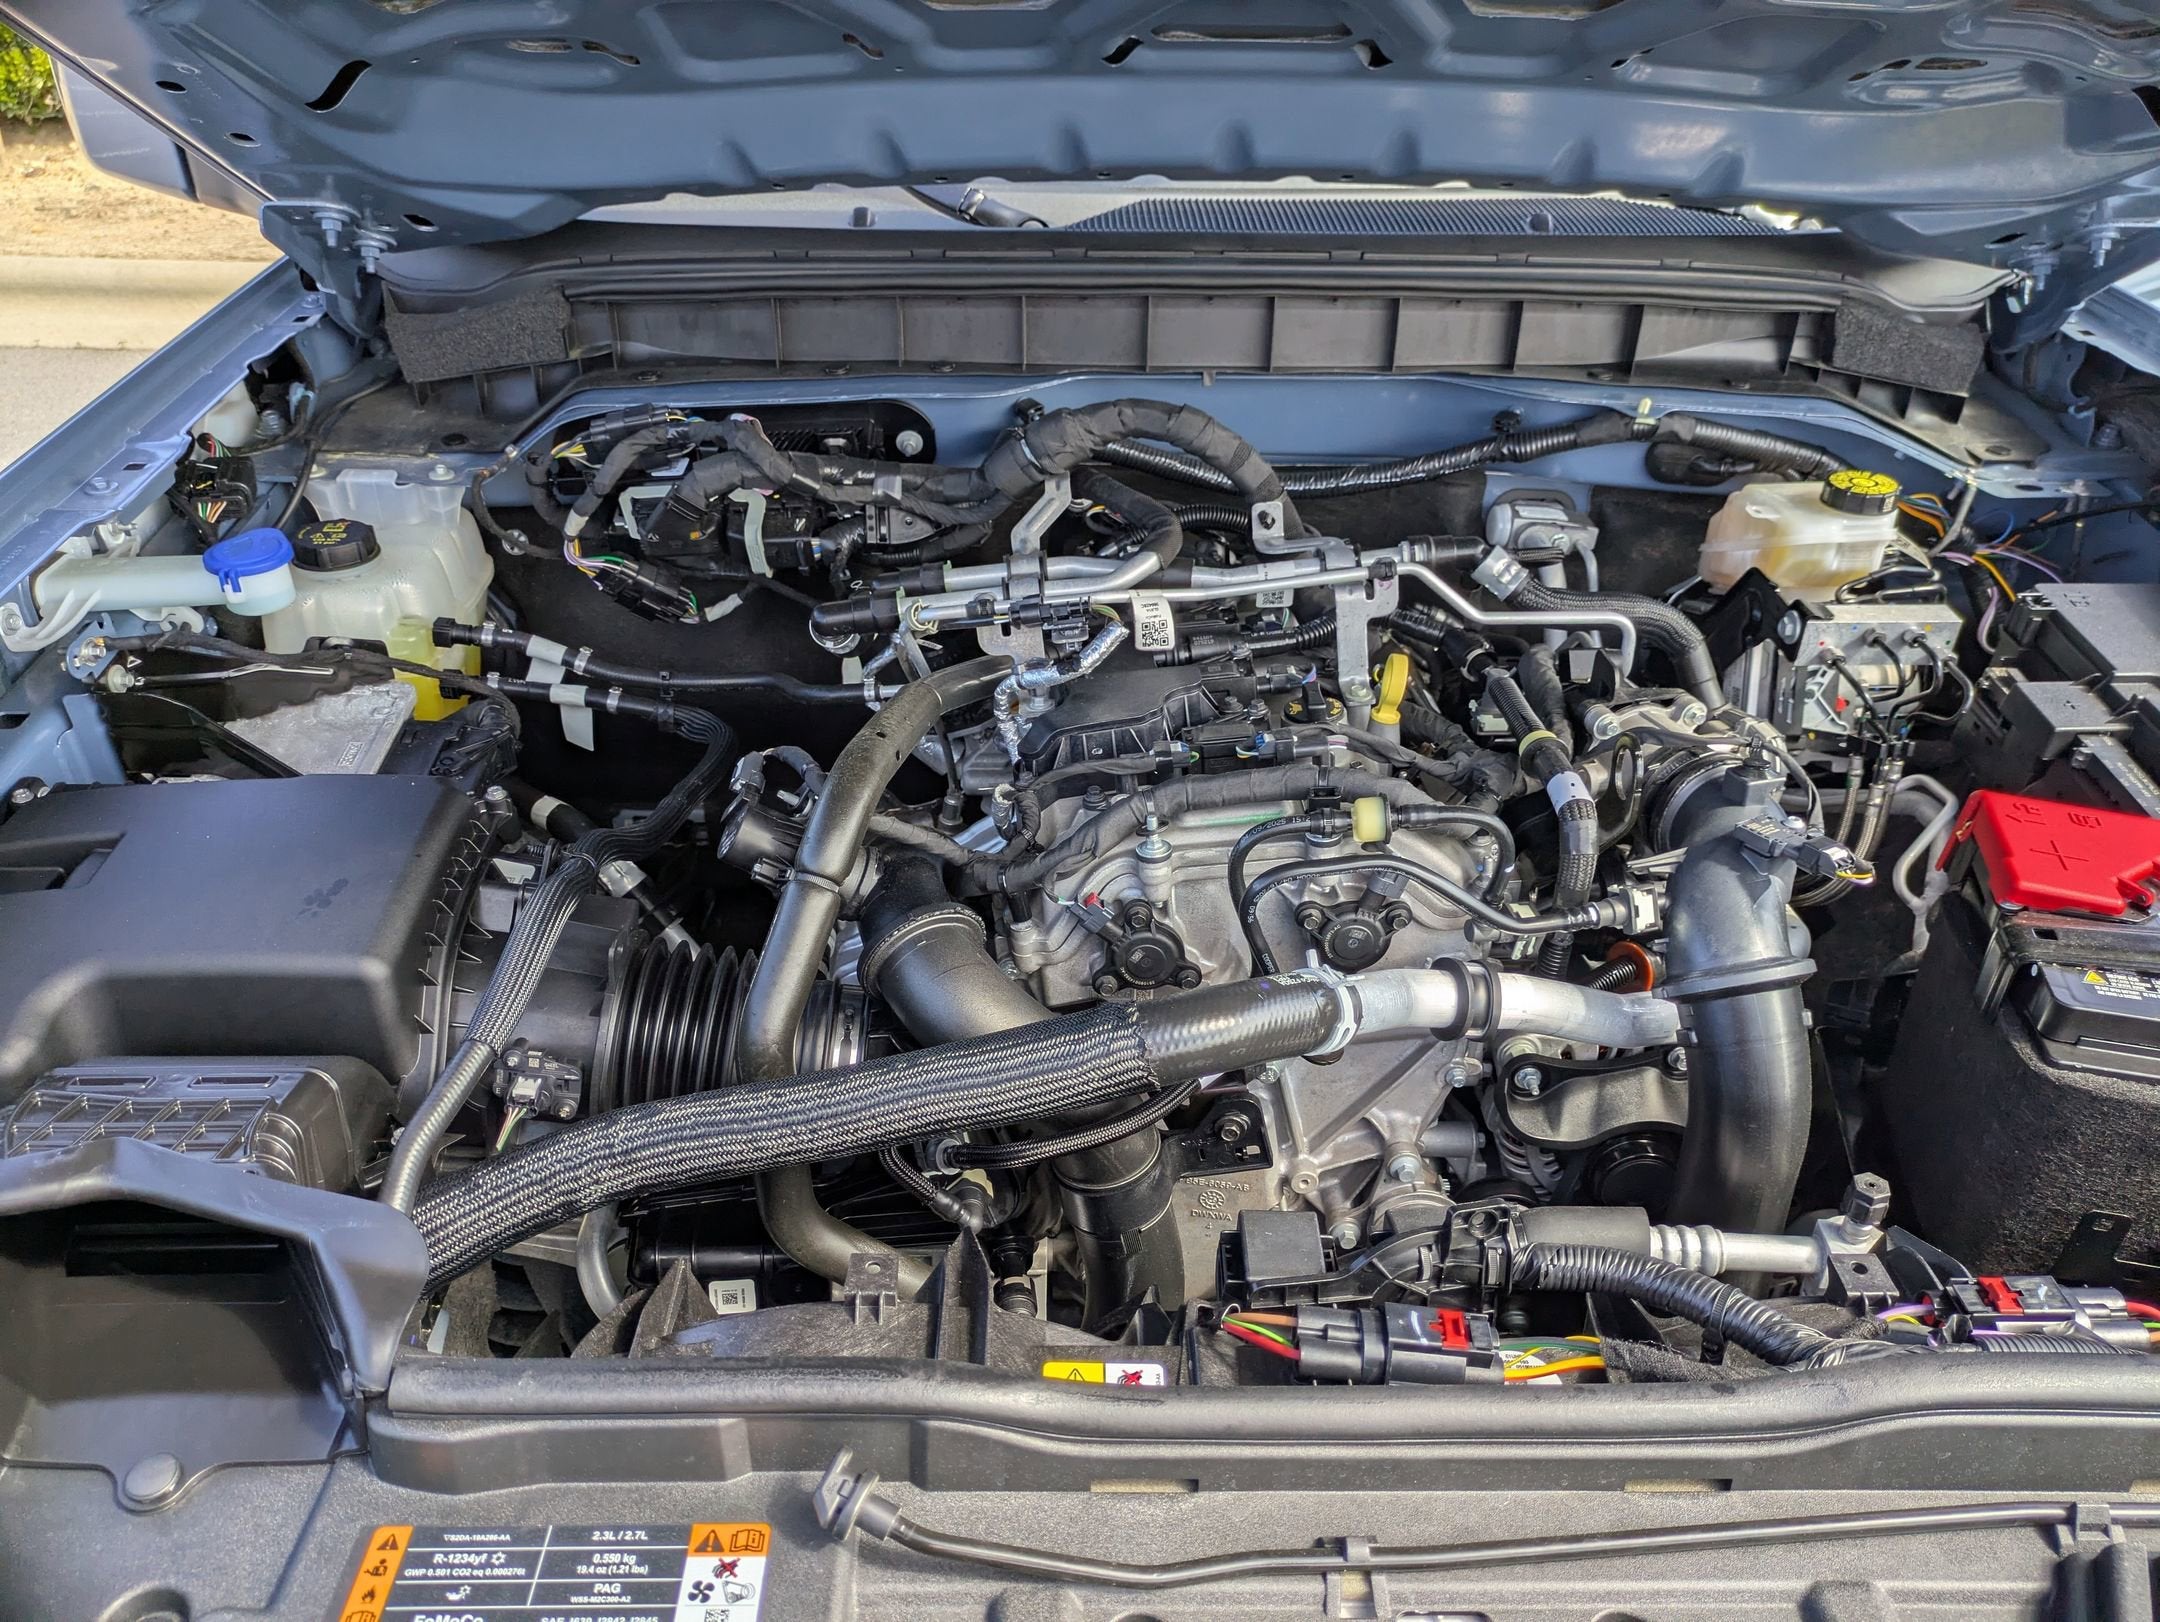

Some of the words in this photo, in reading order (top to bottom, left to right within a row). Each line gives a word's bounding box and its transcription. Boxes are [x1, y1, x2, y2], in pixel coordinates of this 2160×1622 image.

[1261, 953, 1276, 974] COOPER
[592, 1531, 615, 1540] 2.3L
[624, 1531, 648, 1540] 2.7L
[433, 1553, 488, 1566] R-1234yf
[593, 1553, 621, 1564] 0.550
[622, 1553, 636, 1566] kg
[404, 1569, 426, 1577] GWP
[427, 1569, 450, 1577] 0.501
[452, 1568, 471, 1576] CO2
[472, 1570, 484, 1578] eq
[576, 1565, 594, 1575] 19.4
[595, 1567, 607, 1575] oz
[608, 1565, 629, 1576] (1.21
[631, 1565, 649, 1575] lbs)
[593, 1583, 621, 1594] PAG
